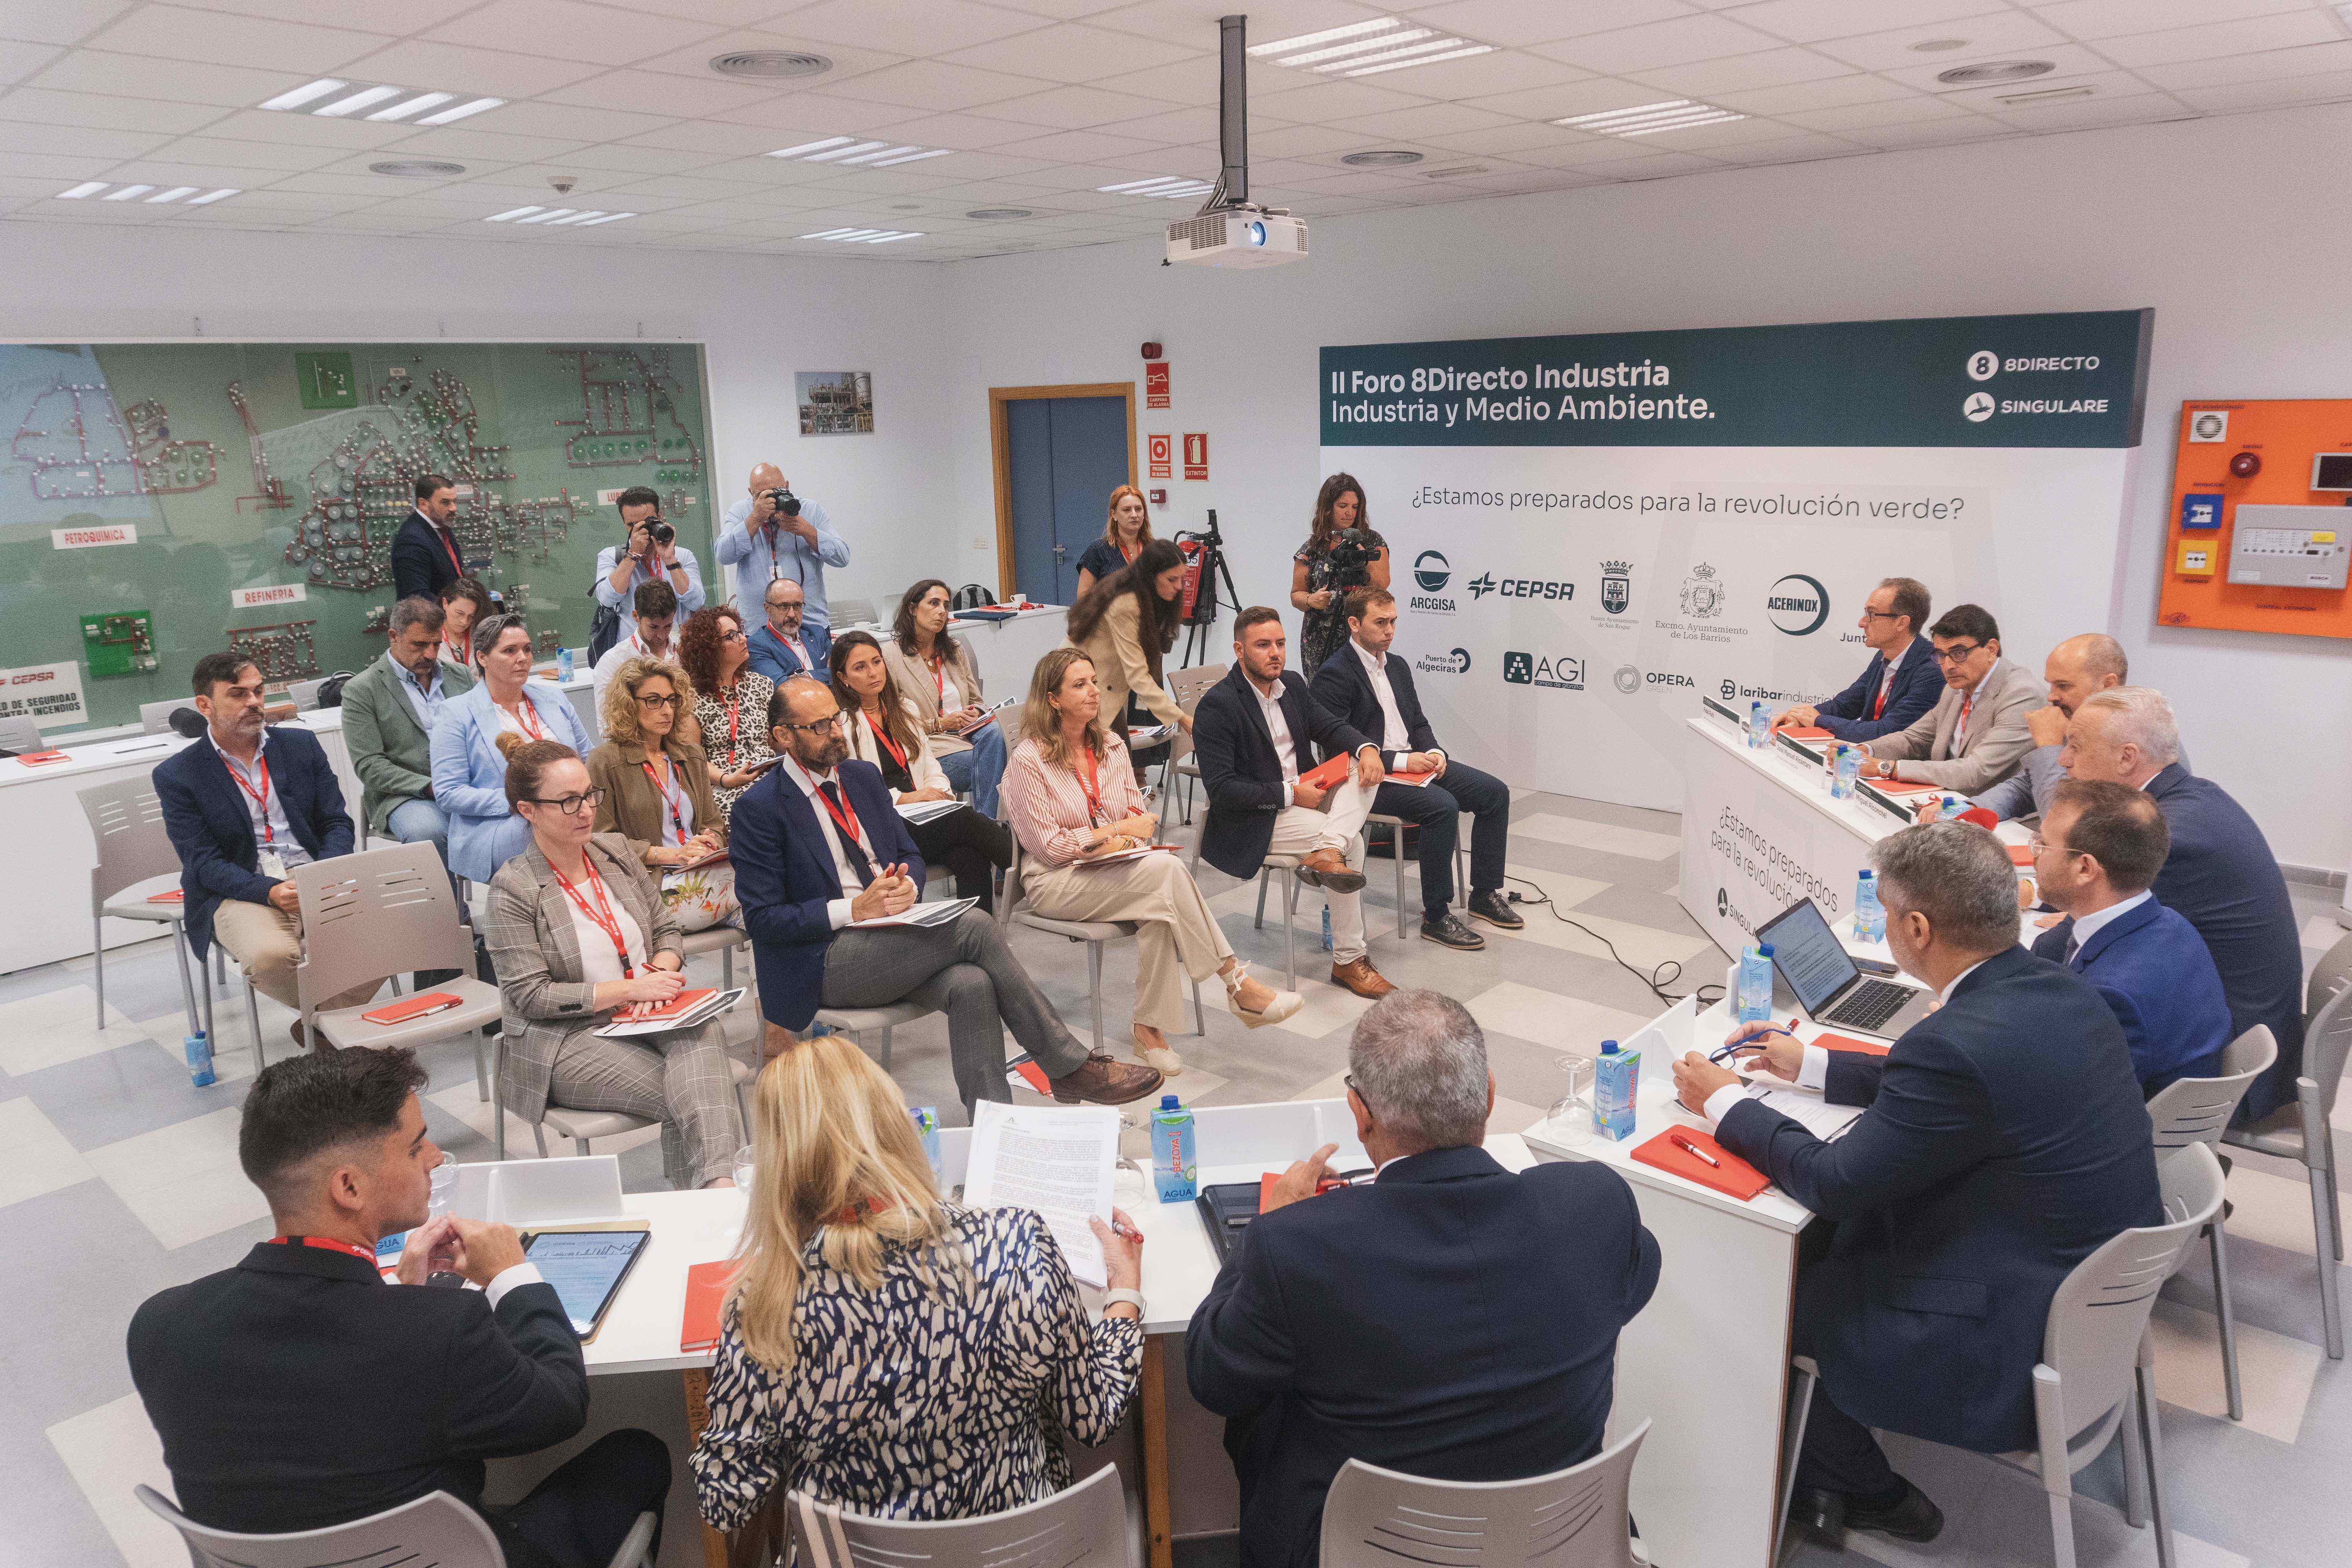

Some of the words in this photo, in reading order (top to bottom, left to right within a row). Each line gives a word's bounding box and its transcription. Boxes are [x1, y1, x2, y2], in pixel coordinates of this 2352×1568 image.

[2004, 356, 2100, 372] 8DIRECTO
[1332, 371, 1345, 394] II
[1352, 368, 1406, 393] Foro
[1411, 365, 1528, 392] 8Directo
[1535, 359, 1670, 388] Industria
[1332, 397, 1438, 423] Industria
[1444, 401, 1459, 428] y
[1466, 396, 1550, 421] Medio
[1557, 393, 1715, 420] Ambiente.
[2000, 399, 2109, 414] SINGULARE
[1412, 486, 1504, 508] ¿Estamos
[1510, 490, 1633, 512] preparados
[1640, 495, 1690, 515] para
[1698, 493, 1716, 513] la
[1724, 494, 1860, 517] revolución
[1869, 497, 1965, 520] verde?
[64, 529, 126, 545] PETROQUIMICA
[244, 588, 295, 604] REFINERIA
[1500, 579, 1575, 601] CEPSA
[1410, 596, 1456, 611] ARCGISA
[1767, 596, 1818, 613] ACERINOX
[1606, 617, 1639, 625] Ayuntamiento
[1655, 620, 1685, 630] Excmo.
[1687, 622, 1748, 635] Ayuntamiento
[1684, 632, 1698, 640] Los
[1700, 633, 1731, 643] Barrios
[1840, 632, 1867, 643] Junt
[1426, 654, 1446, 663] Puerto
[1416, 661, 1456, 673] Algeciras
[1534, 655, 1585, 683] AGI
[11, 671, 54, 685] CEPSA
[1646, 673, 1695, 688] OPERA
[1646, 685, 1672, 693] GREEN
[11, 700, 23, 709] DE
[27, 692, 77, 707] SEGURIDAD
[33, 702, 81, 716] INCENDIOS
[1719, 806, 1767, 857] ¿Estamos
[1769, 844, 1838, 913] preparados
[1711, 829, 1732, 860] para
[1733, 842, 1741, 867] la
[1744, 856, 1798, 909] revolució
[1729, 904, 1757, 941] SINGULA
[1171, 1138, 1182, 1173] BEZOYA
[1163, 1188, 1193, 1198] AGUA
[376, 1238, 399, 1250] GUA
